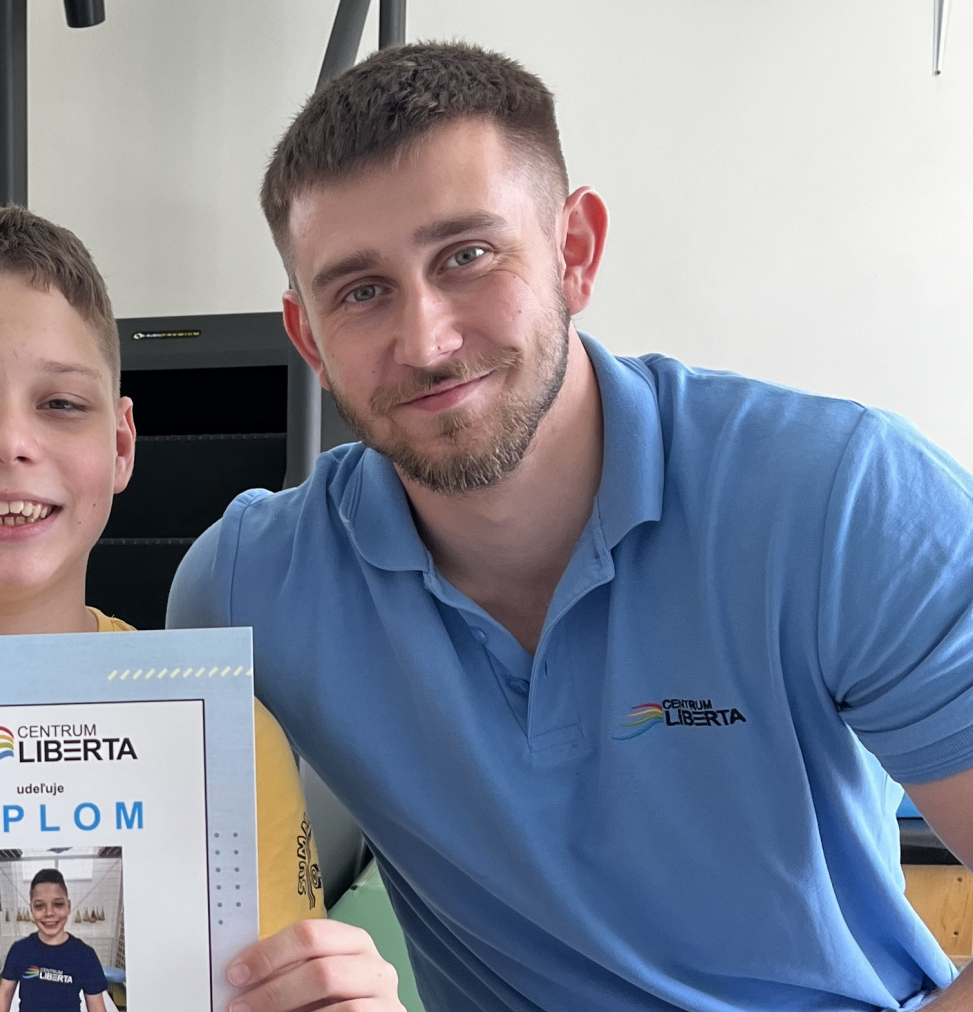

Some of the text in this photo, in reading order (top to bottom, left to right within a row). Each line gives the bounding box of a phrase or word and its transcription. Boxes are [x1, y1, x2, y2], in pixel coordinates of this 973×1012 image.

[662, 699, 713, 710] CENTRUM
[665, 708, 747, 726] LIBERTA
[17, 724, 97, 739] CENTRUM
[18, 737, 138, 763] LIBERTA
[16, 782, 65, 796] udeľuje
[39, 972, 73, 984] LIBERTA
